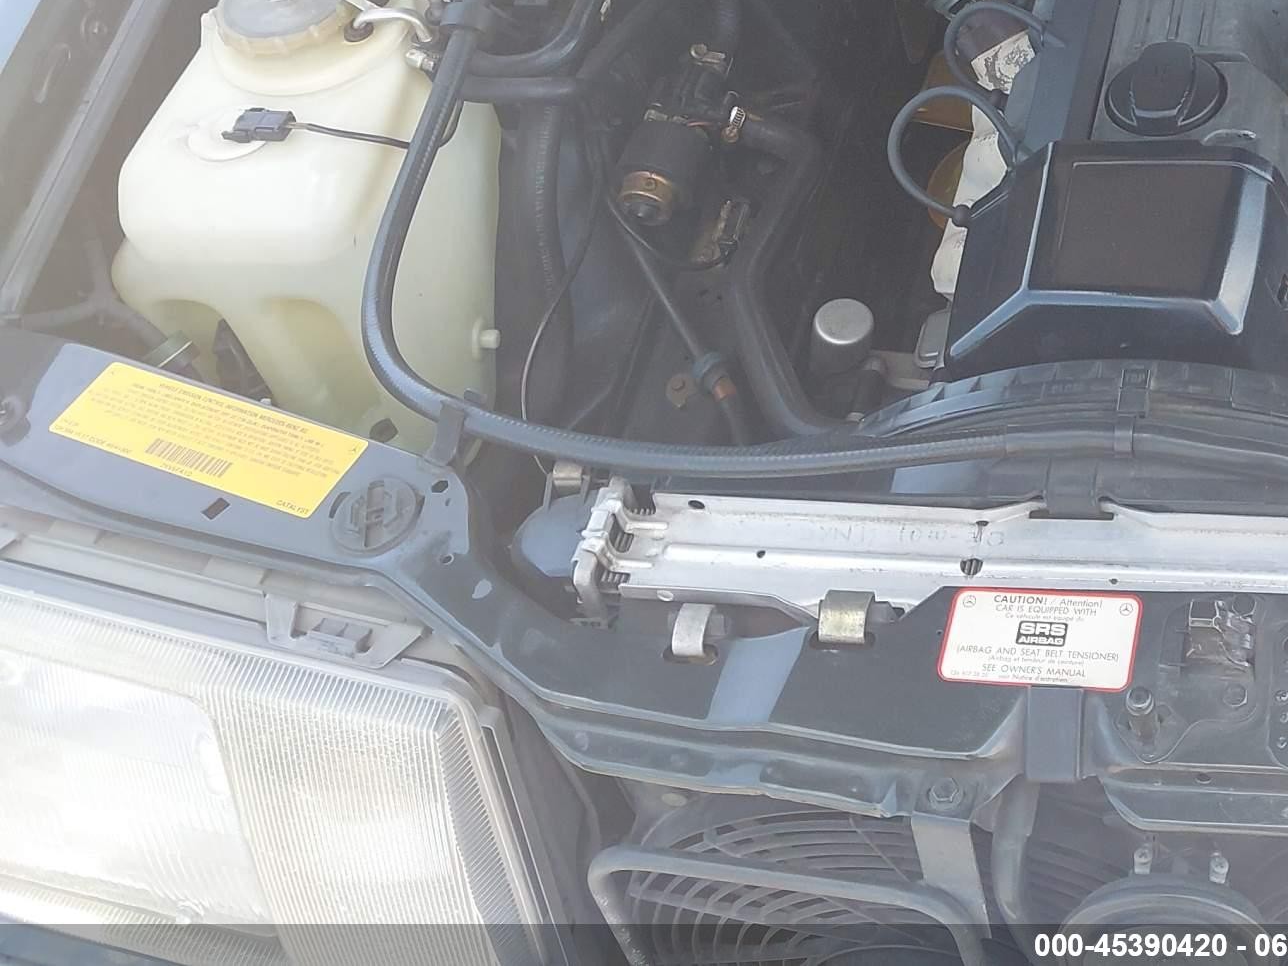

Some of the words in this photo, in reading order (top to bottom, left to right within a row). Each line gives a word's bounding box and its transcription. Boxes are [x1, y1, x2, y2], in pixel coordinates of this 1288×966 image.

[994, 595, 1048, 604] CAUTION!
[1060, 598, 1102, 608] Attention!
[996, 604, 1013, 612] CAR
[1028, 606, 1069, 615] EQUIPPED
[1073, 608, 1096, 616] WITH
[1020, 622, 1066, 636] SRS
[1019, 636, 1064, 645] AIRBAG
[957, 645, 992, 654] (AIRBAG
[997, 646, 1016, 655] AND
[1020, 648, 1040, 656] SEAT
[1045, 649, 1063, 657] BELT
[1067, 650, 1119, 661] TENSIONER)
[982, 664, 996, 672] SEE
[1001, 665, 1042, 675] OWNER'S
[1046, 667, 1086, 677] MANUAL
